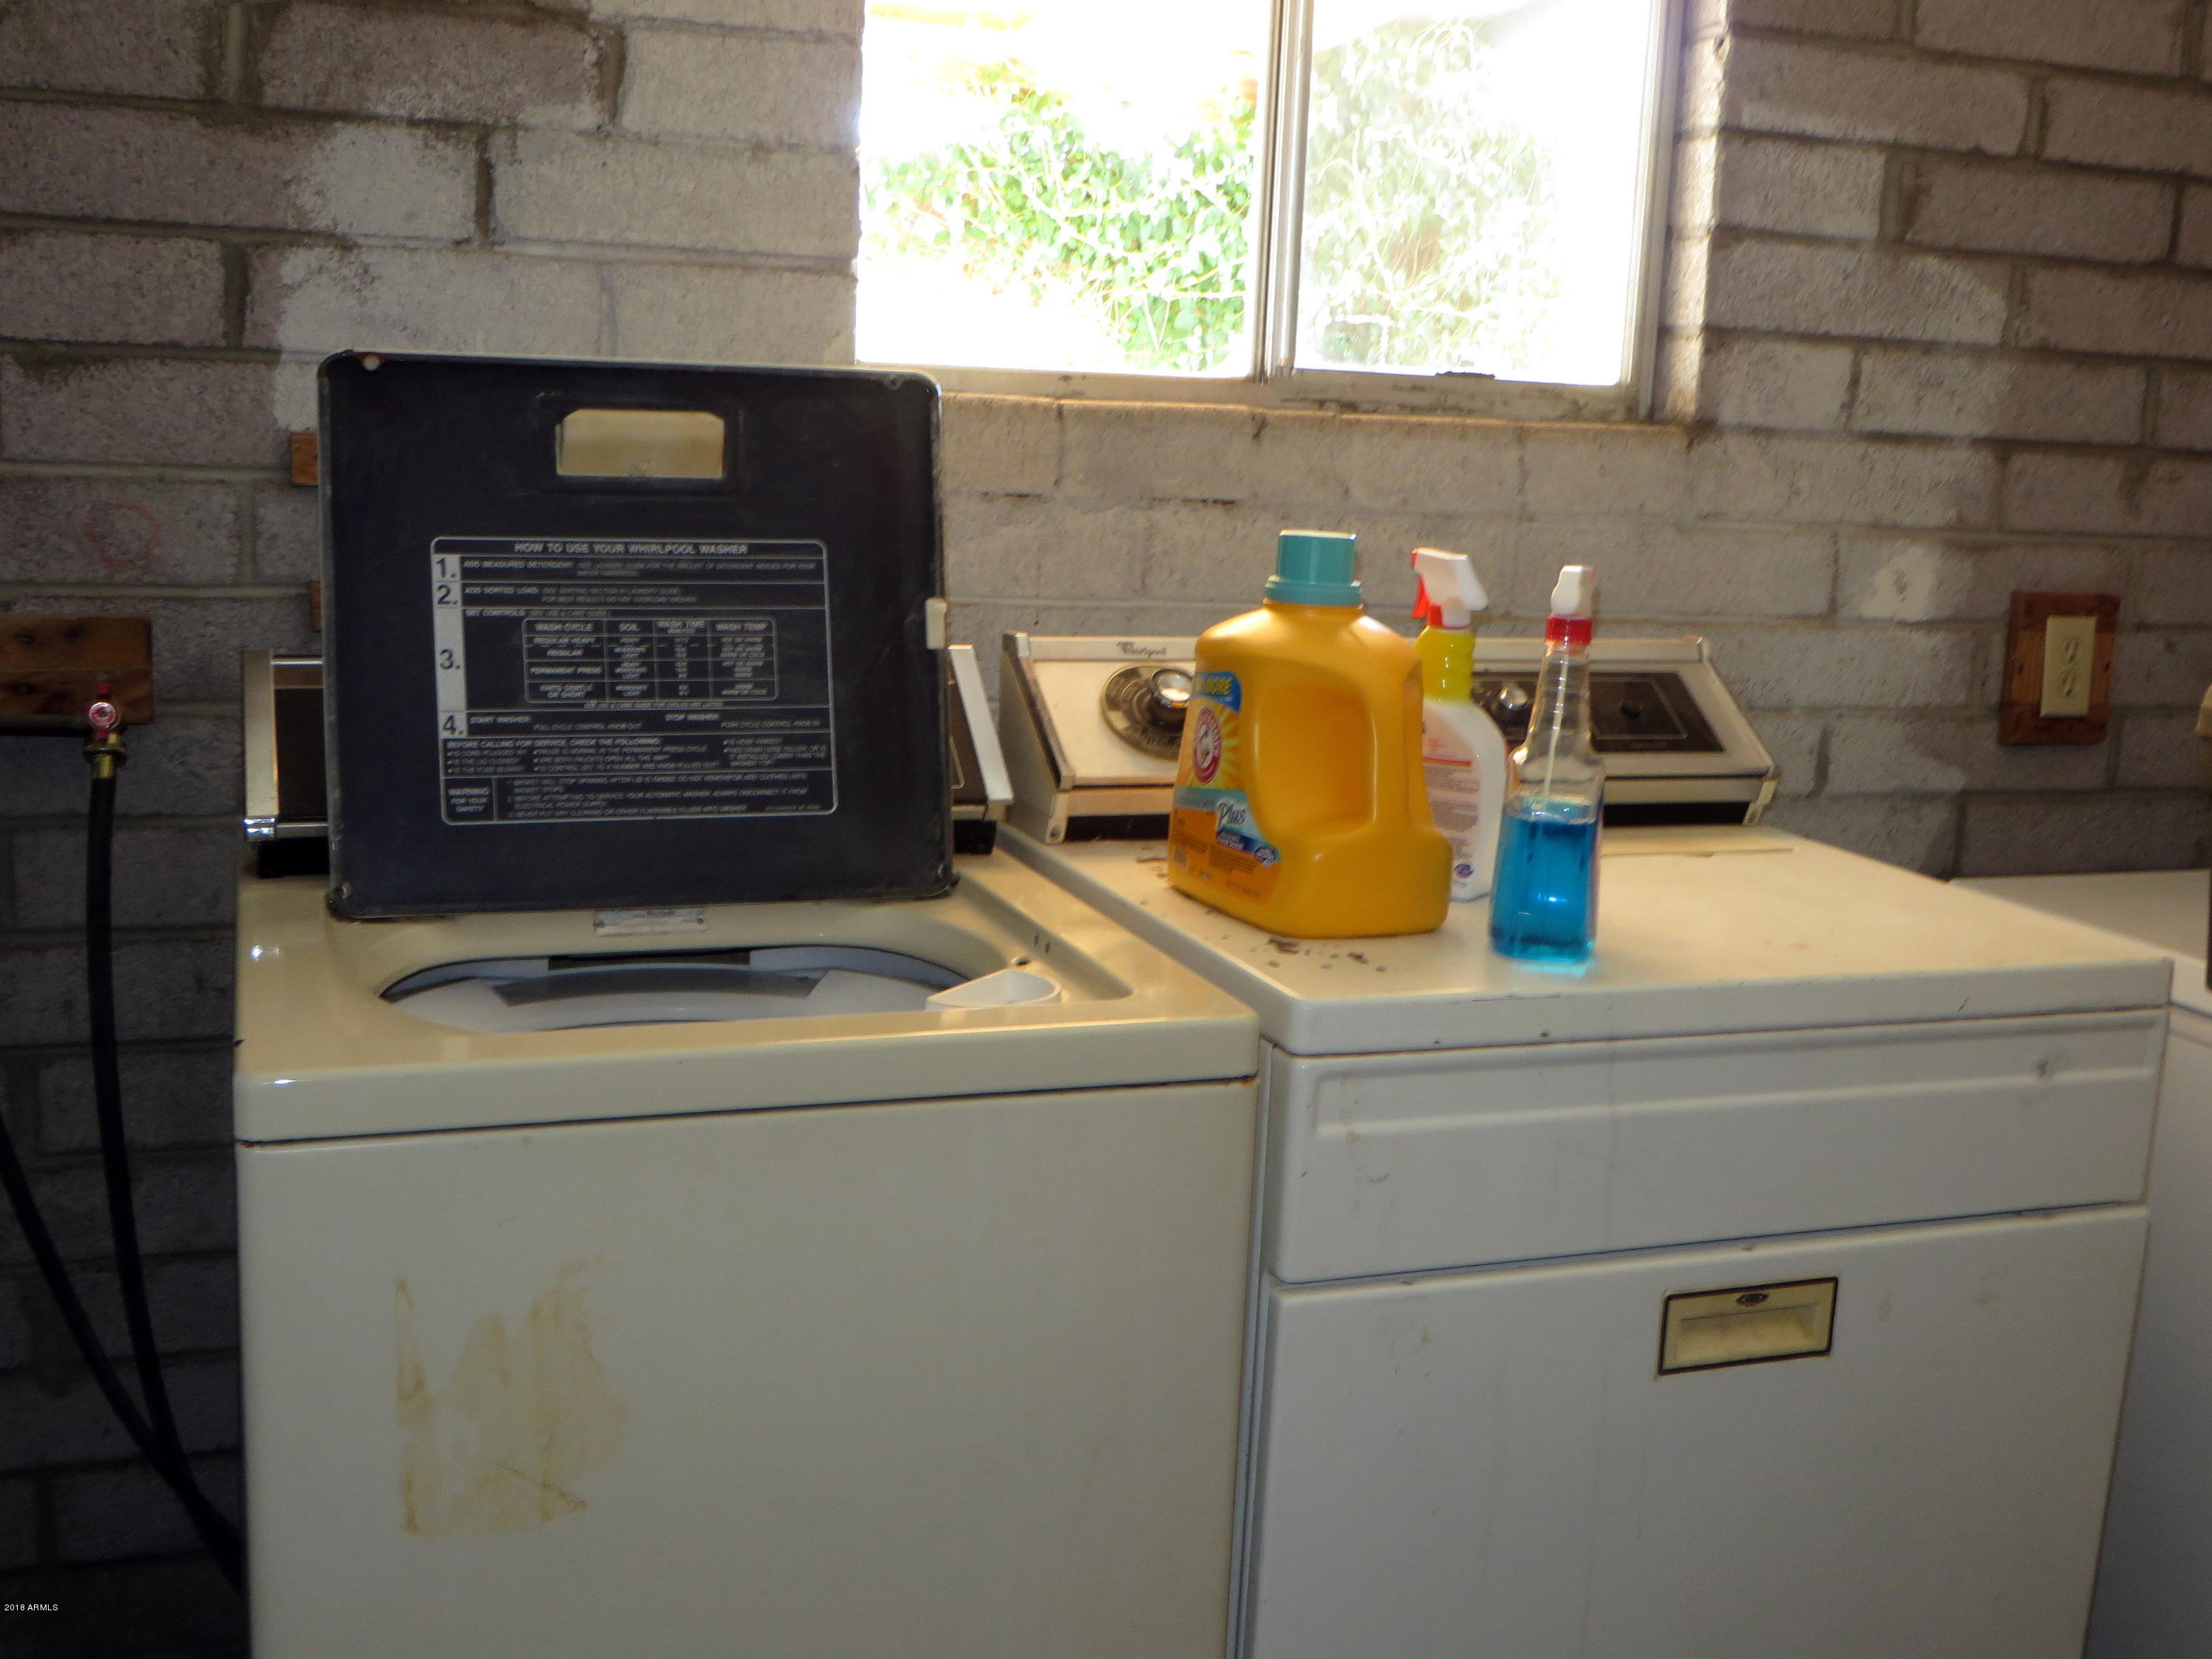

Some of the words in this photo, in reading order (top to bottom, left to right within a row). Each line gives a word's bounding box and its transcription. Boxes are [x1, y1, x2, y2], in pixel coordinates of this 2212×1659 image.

[514, 542, 543, 553] HOW
[546, 542, 564, 554] TO
[566, 543, 591, 554] USE
[593, 543, 626, 554] YOUR
[627, 543, 698, 554] WHIRLPOOL
[699, 543, 748, 555] WASHER
[436, 558, 456, 578] 1.
[437, 585, 459, 605] 2.
[439, 649, 461, 669] 3.
[442, 715, 465, 735] 4.
[1217, 802, 1246, 828] Plus
